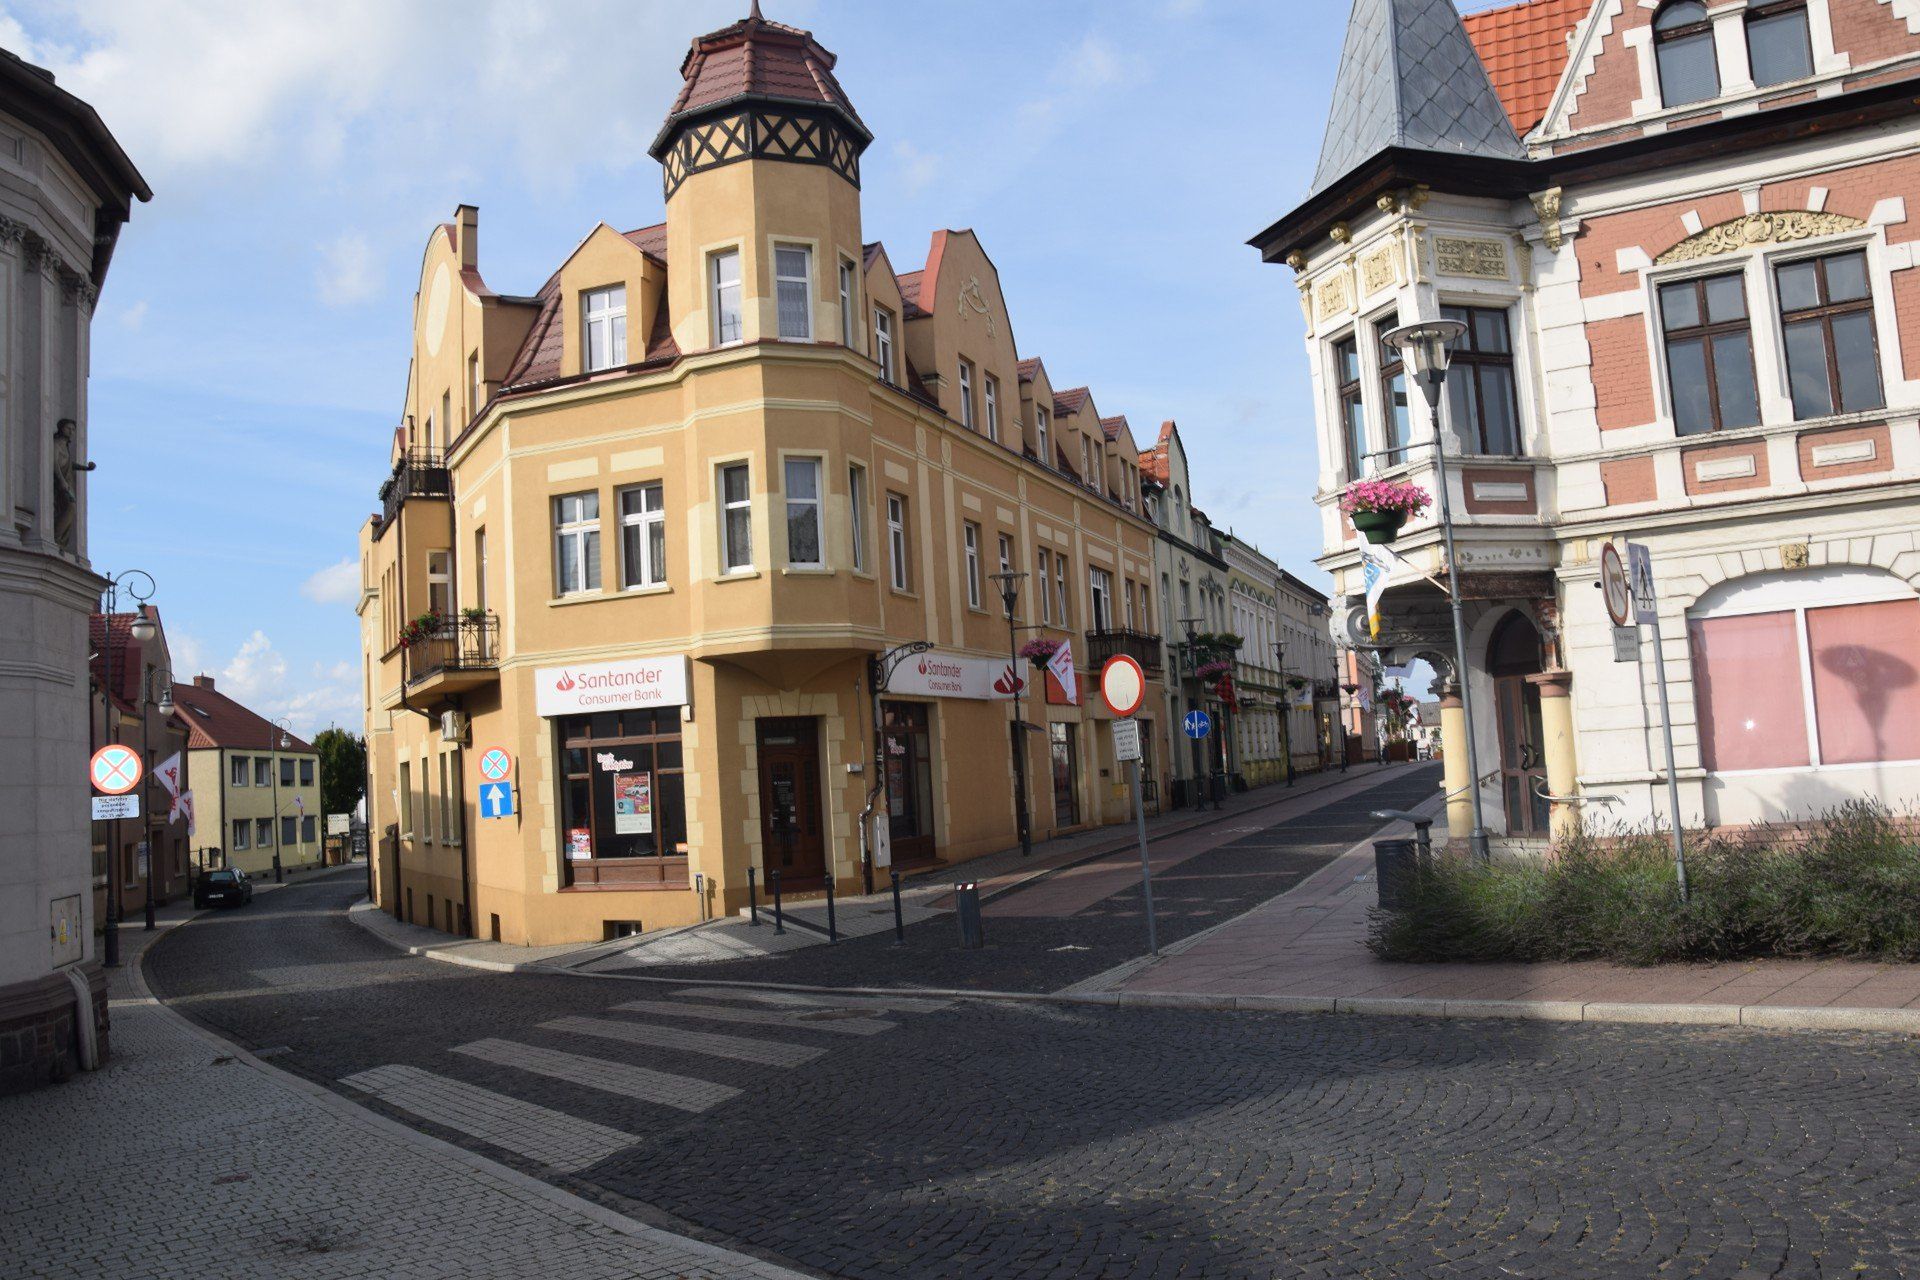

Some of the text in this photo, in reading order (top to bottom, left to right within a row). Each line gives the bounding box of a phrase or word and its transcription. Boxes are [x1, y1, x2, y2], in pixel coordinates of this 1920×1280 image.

[927, 660, 962, 678] Santander
[578, 668, 662, 689] Santander
[928, 679, 962, 692] Consumer Bank
[578, 688, 662, 706] Consumer Bank
